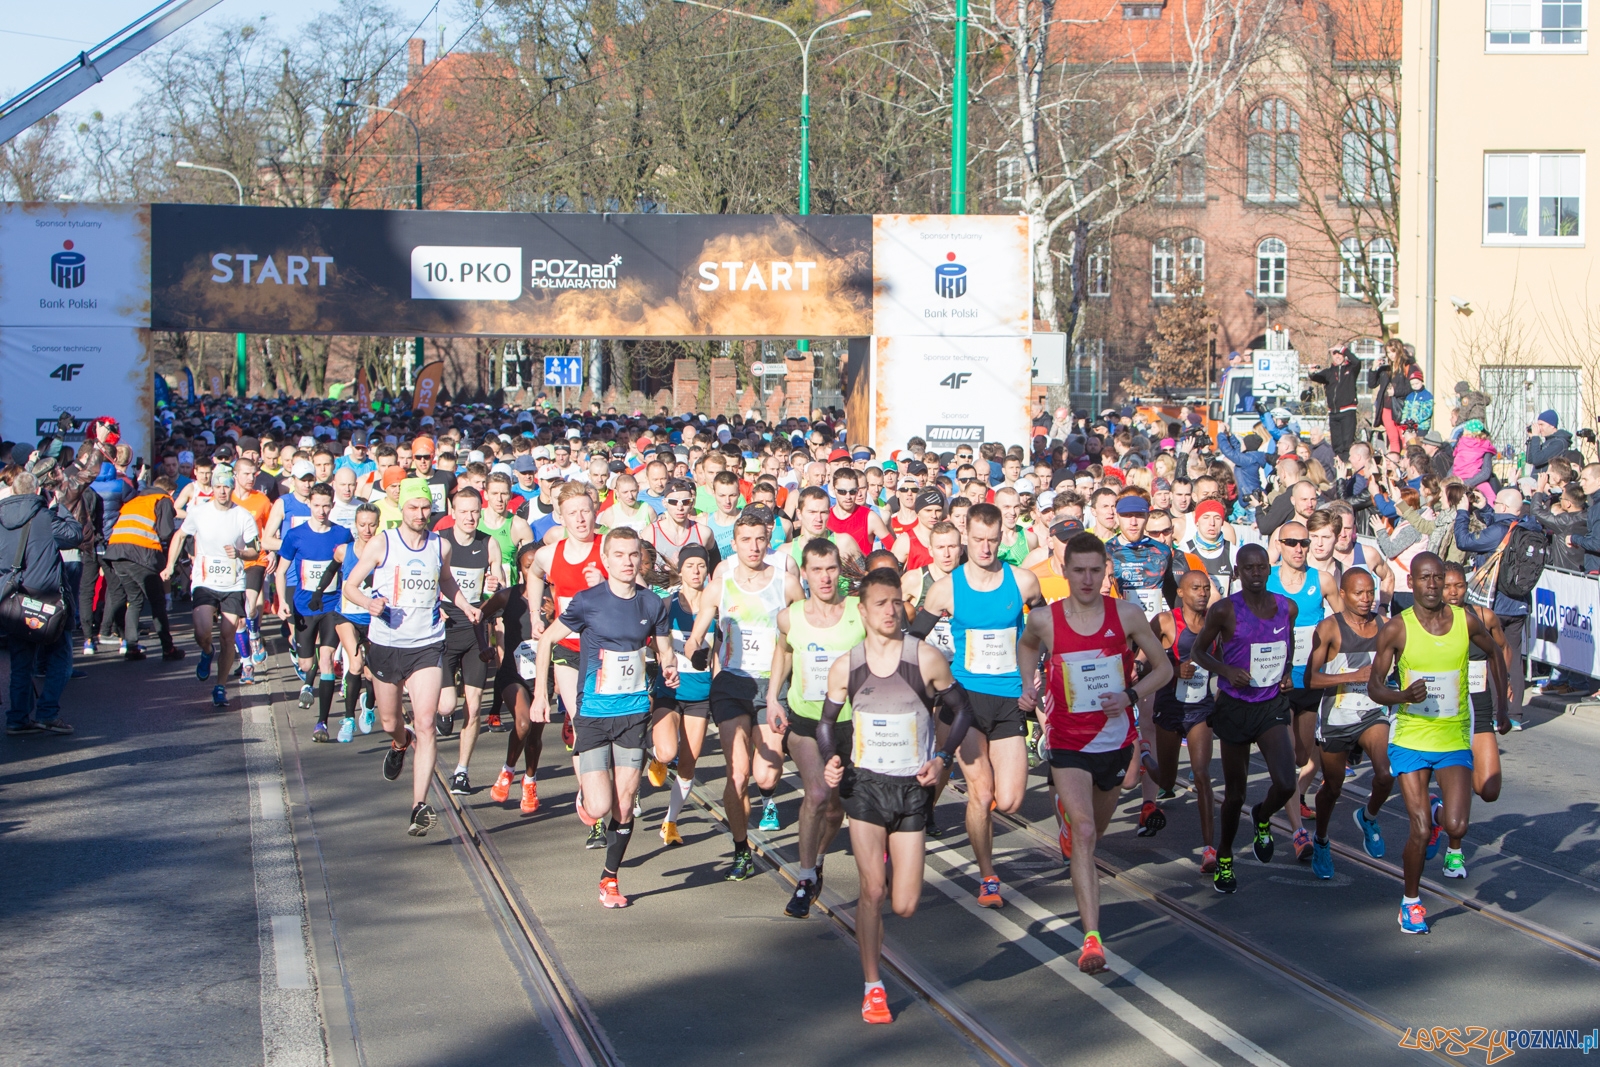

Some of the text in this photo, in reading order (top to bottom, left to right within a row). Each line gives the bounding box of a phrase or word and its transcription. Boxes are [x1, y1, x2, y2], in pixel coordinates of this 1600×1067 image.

[35, 219, 103, 229] Sponsor tytularny
[920, 232, 983, 241] Sponsor tytularny
[211, 253, 334, 286] START
[422, 261, 512, 284] 10. PKO
[698, 261, 817, 292] START
[531, 276, 617, 290] PÓŁMARATON
[40, 299, 98, 309] Bank Polski
[924, 309, 978, 318] Bank Polski
[32, 344, 102, 353] Sponsor techniczny
[923, 353, 989, 363] Sponsor techniczny
[50, 364, 85, 381] 4F
[940, 372, 972, 389] 4F
[417, 378, 435, 410] 1:30
[53, 404, 83, 413] Sponsor
[941, 411, 970, 420] Sponsor
[928, 427, 982, 440] 4MOVE
[208, 565, 232, 575] 8892
[401, 578, 436, 590] 10902
[1537, 602, 1556, 627] PKO
[937, 634, 949, 646] 15
[620, 664, 635, 677] 16
[1084, 673, 1110, 683] Szymon
[860, 686, 876, 695] 4F
[1087, 682, 1109, 691] Kulka
[866, 739, 909, 747] Chabowski
